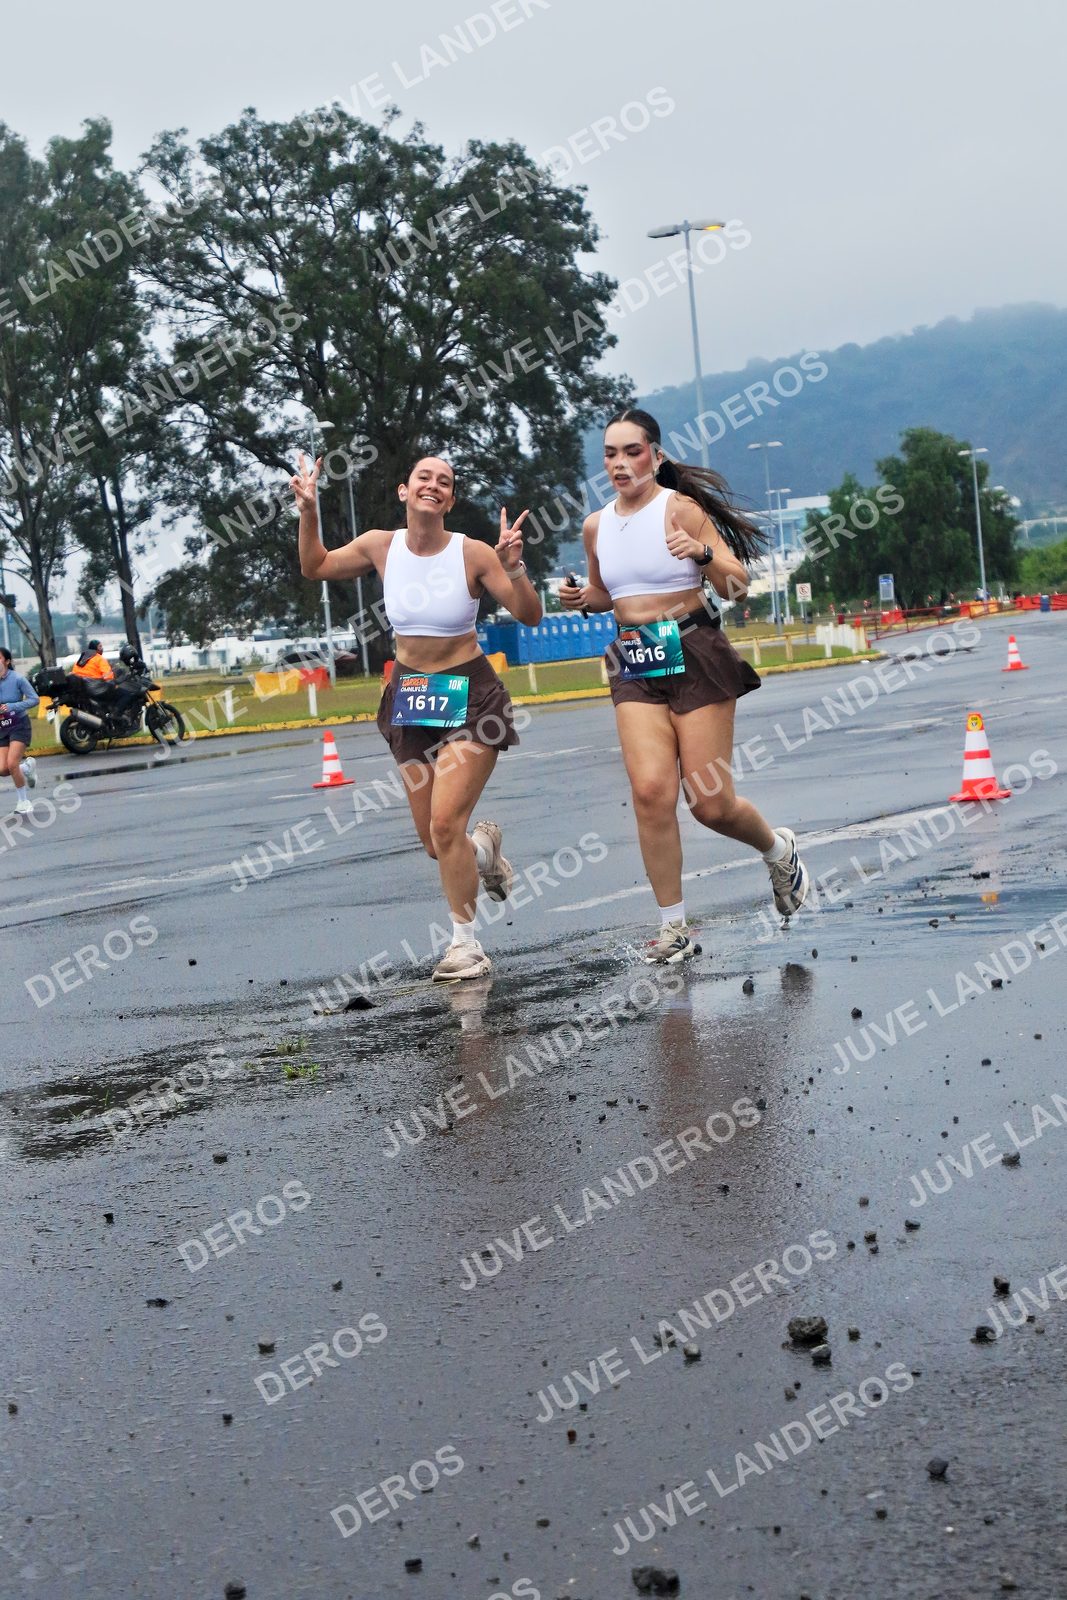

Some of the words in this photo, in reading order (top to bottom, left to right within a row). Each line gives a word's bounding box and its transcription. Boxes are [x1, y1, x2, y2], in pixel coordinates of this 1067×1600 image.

[658, 625, 672, 637] 10K
[628, 646, 665, 663] 1616
[448, 680, 463, 690] 10K
[407, 695, 449, 711] 1617
